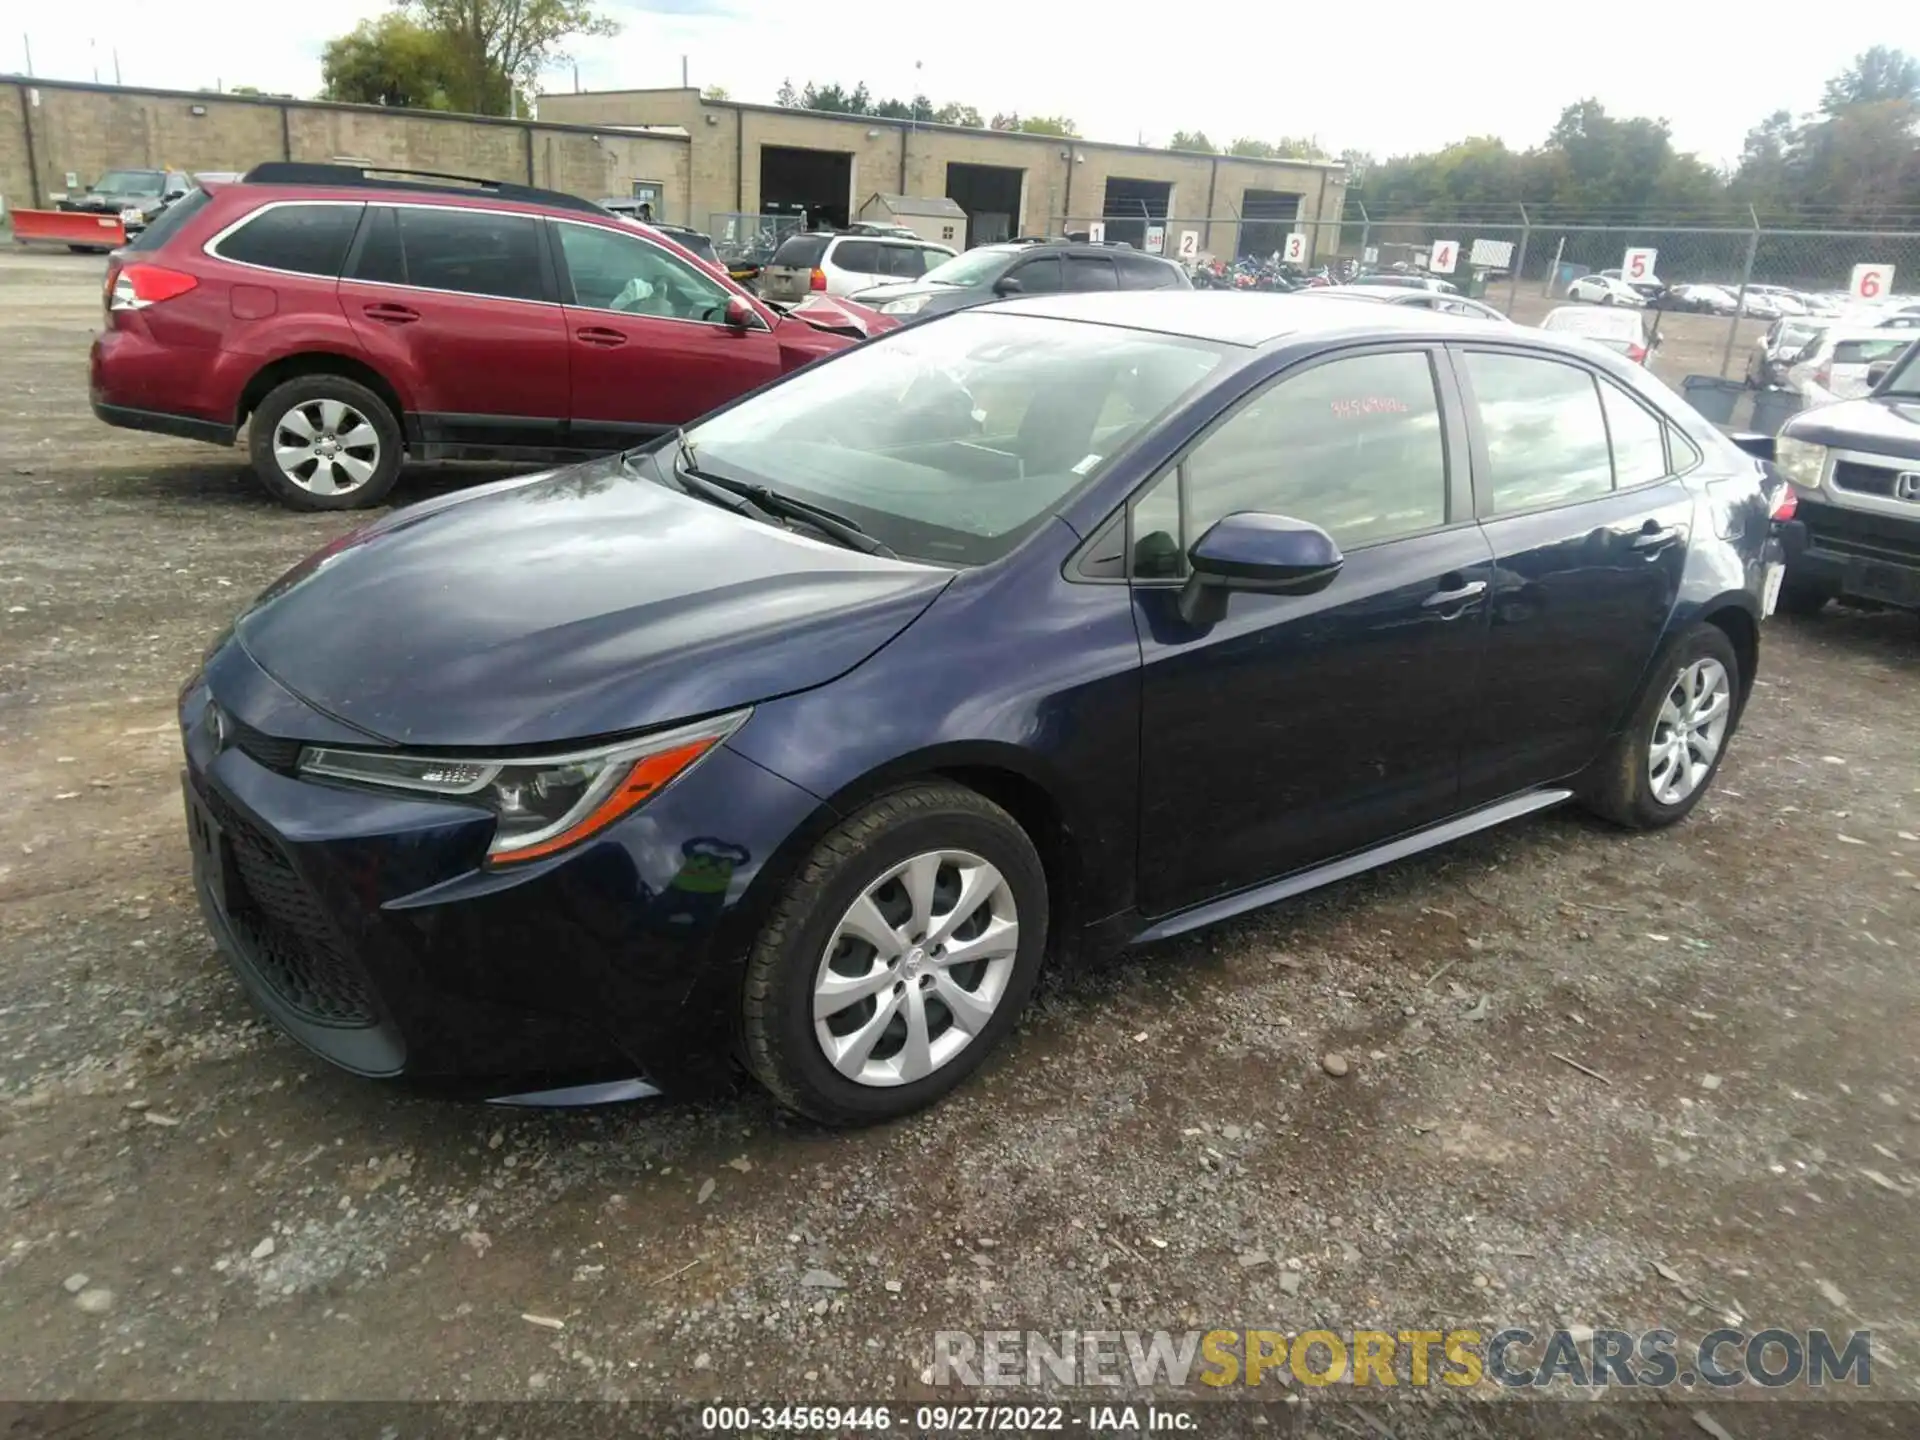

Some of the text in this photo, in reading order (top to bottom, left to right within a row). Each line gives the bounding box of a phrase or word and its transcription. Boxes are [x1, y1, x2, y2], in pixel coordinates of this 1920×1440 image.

[1183, 235, 1194, 254] 2
[1290, 238, 1301, 258] 3
[1437, 246, 1450, 268] 4
[1630, 254, 1647, 278] 5
[1860, 271, 1880, 298] 6
